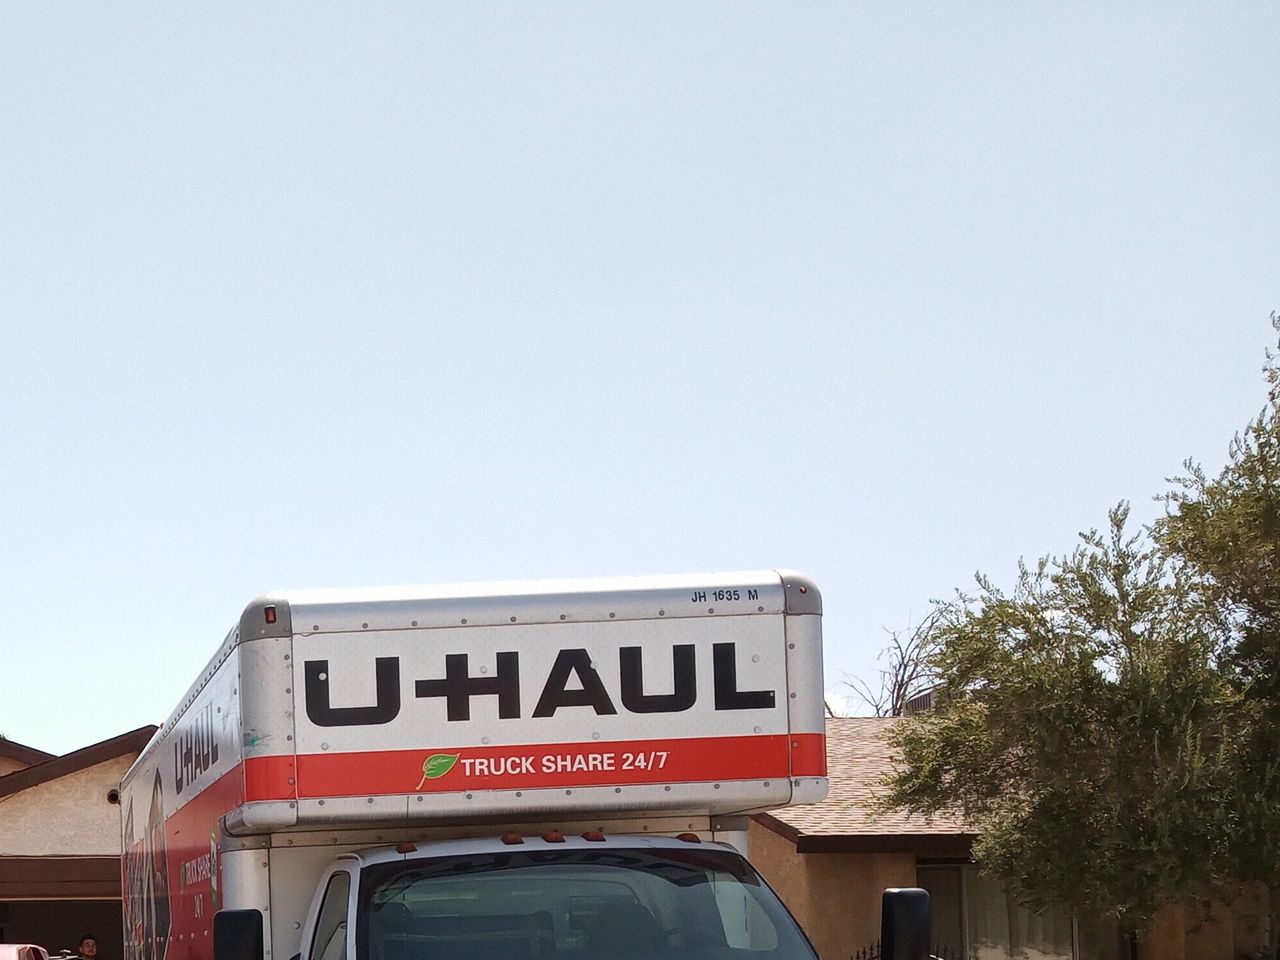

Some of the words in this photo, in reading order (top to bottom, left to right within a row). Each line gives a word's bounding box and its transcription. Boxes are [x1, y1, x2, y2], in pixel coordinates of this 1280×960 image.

[691, 591, 707, 603] JH
[712, 589, 740, 602] 1635
[747, 588, 759, 601] M
[304, 642, 776, 727] U-HAUL
[460, 755, 536, 776] TRUCK
[541, 753, 616, 774] SHARE
[621, 751, 668, 772] 24/7
